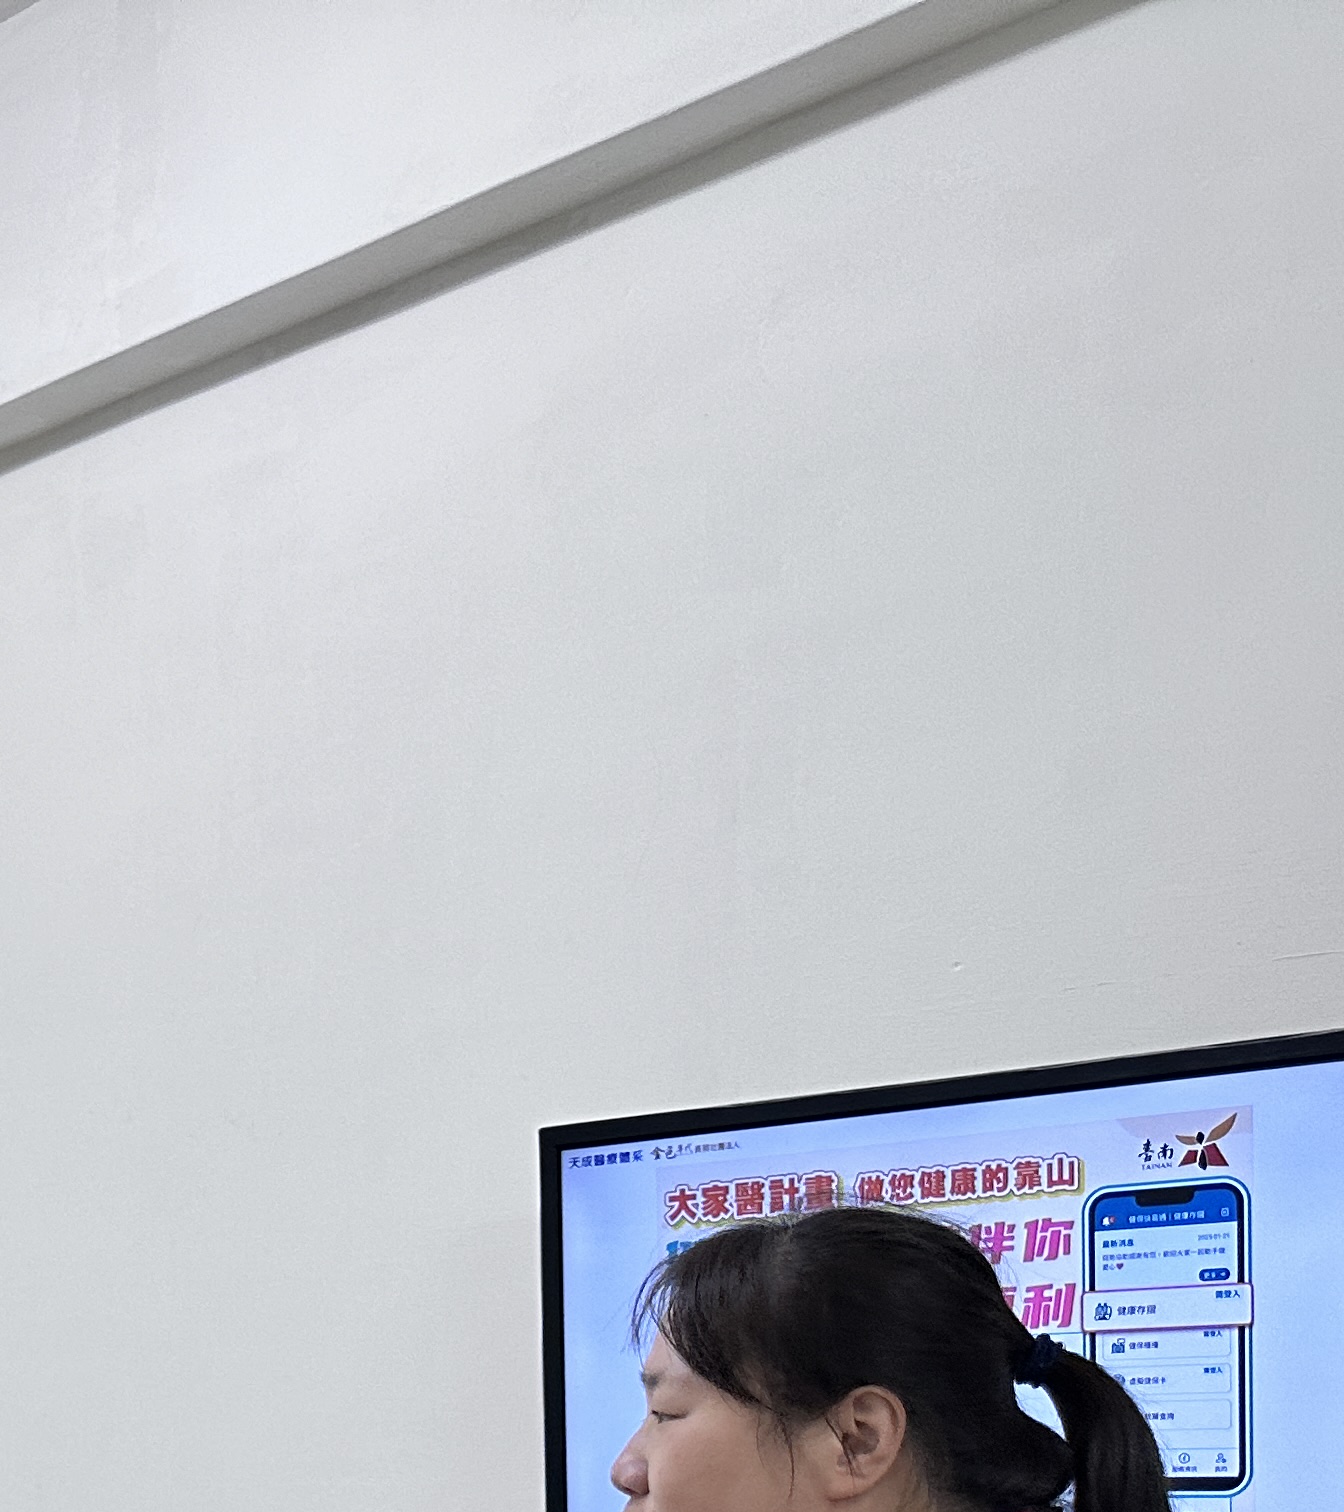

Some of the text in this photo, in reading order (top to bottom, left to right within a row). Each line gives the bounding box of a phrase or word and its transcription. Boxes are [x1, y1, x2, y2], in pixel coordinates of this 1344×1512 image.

[568, 1149, 644, 1169] 天成醫療體系
[666, 1156, 1078, 1224] 大家醫計畫 做您健康的靠山
